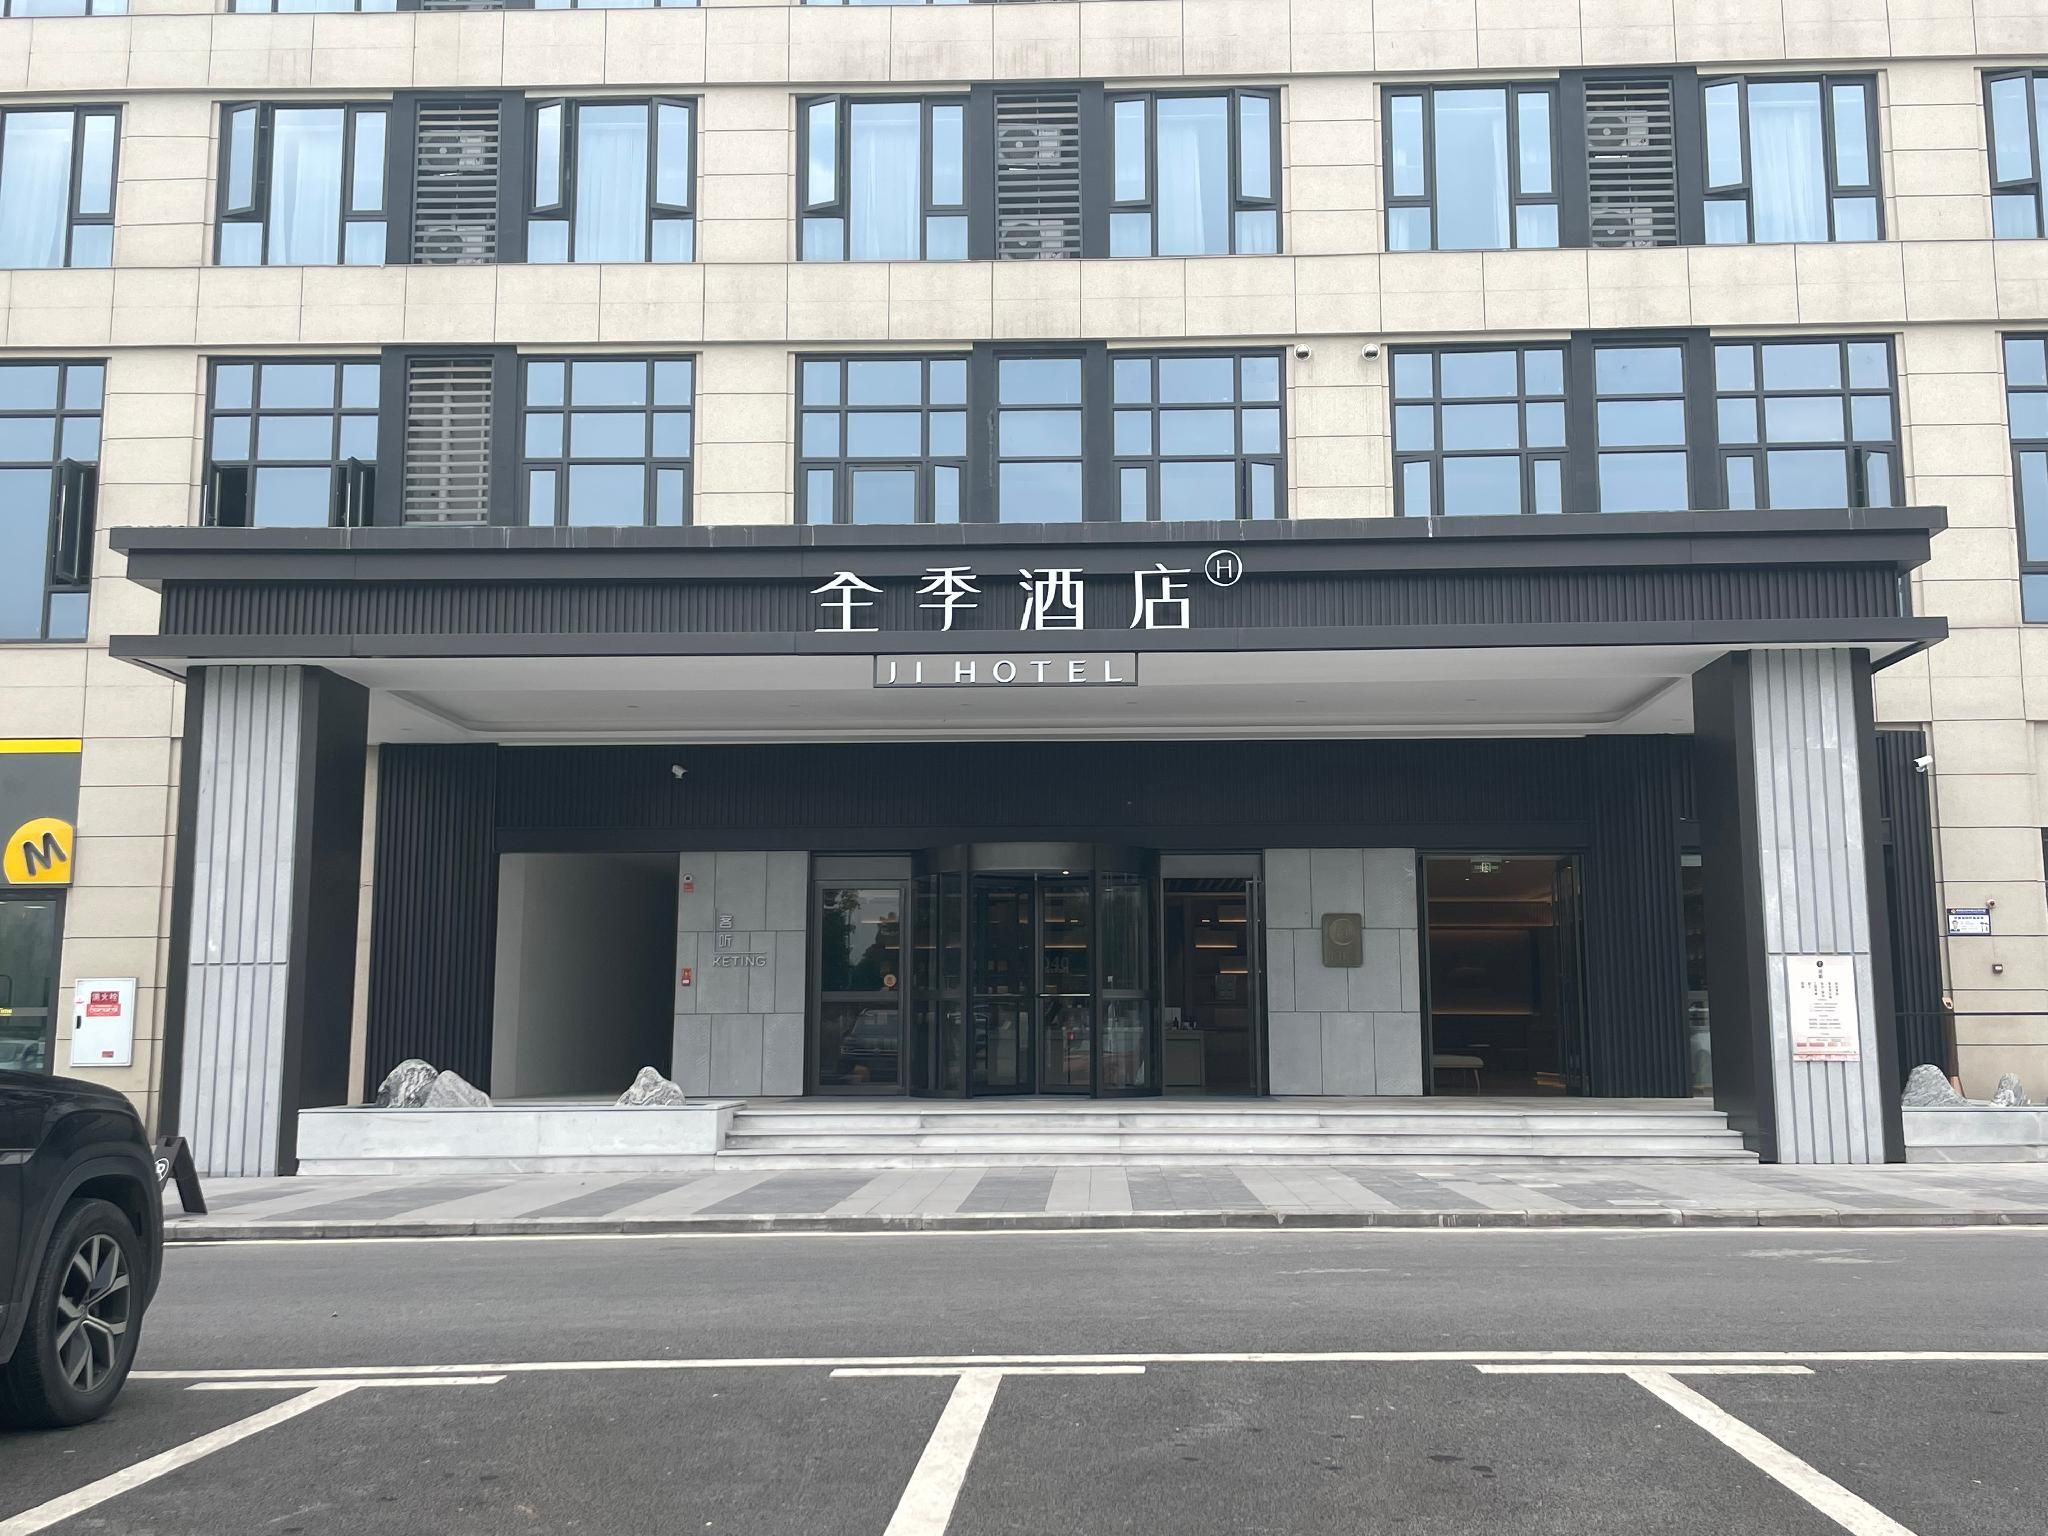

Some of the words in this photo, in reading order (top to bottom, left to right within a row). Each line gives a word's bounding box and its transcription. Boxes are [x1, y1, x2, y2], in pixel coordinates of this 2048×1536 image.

[809, 565, 1192, 633] 全季酒店
[888, 660, 922, 684] JI
[954, 659, 1123, 684] HOTEL
[23, 832, 66, 876] M
[713, 955, 767, 968] KETING
